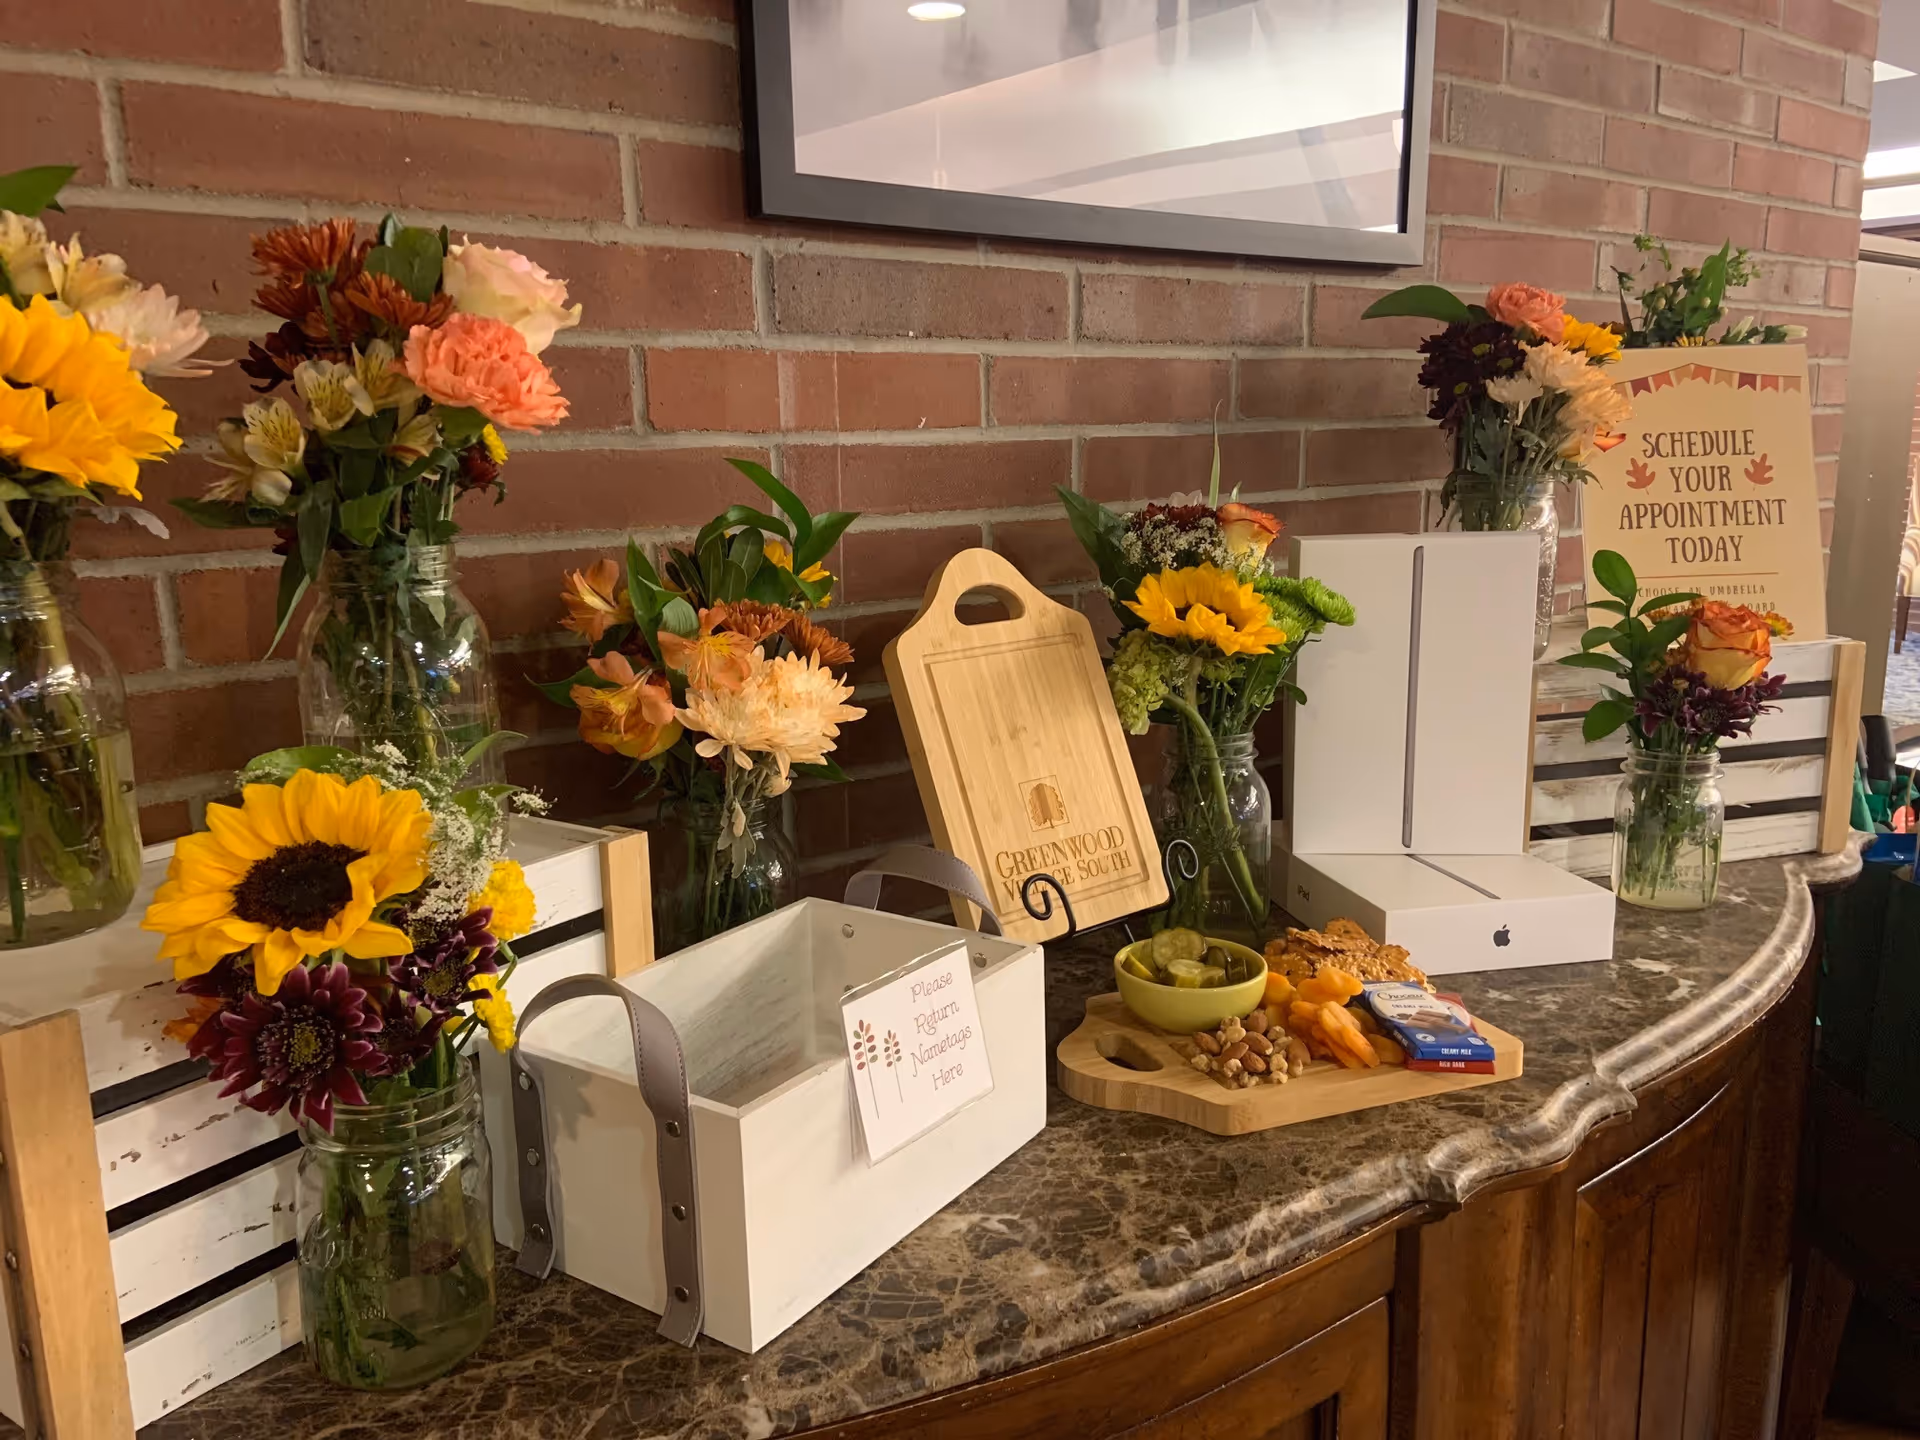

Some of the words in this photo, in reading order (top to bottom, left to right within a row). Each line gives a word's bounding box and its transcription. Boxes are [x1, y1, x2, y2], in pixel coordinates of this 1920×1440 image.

[1641, 429, 1756, 459] SCHEDULE
[1668, 465, 1733, 493] YOUR
[1618, 498, 1787, 530] APPOINTMENT
[1664, 535, 1744, 564] TODAY
[1709, 584, 1765, 596] UMBRELLA
[994, 825, 1125, 879] GREENWOOD
[1076, 849, 1133, 882] SOUTH
[910, 971, 954, 1003] Please
[914, 1000, 960, 1036] Return
[910, 1025, 972, 1078] Nametags
[931, 1062, 964, 1091] Here
